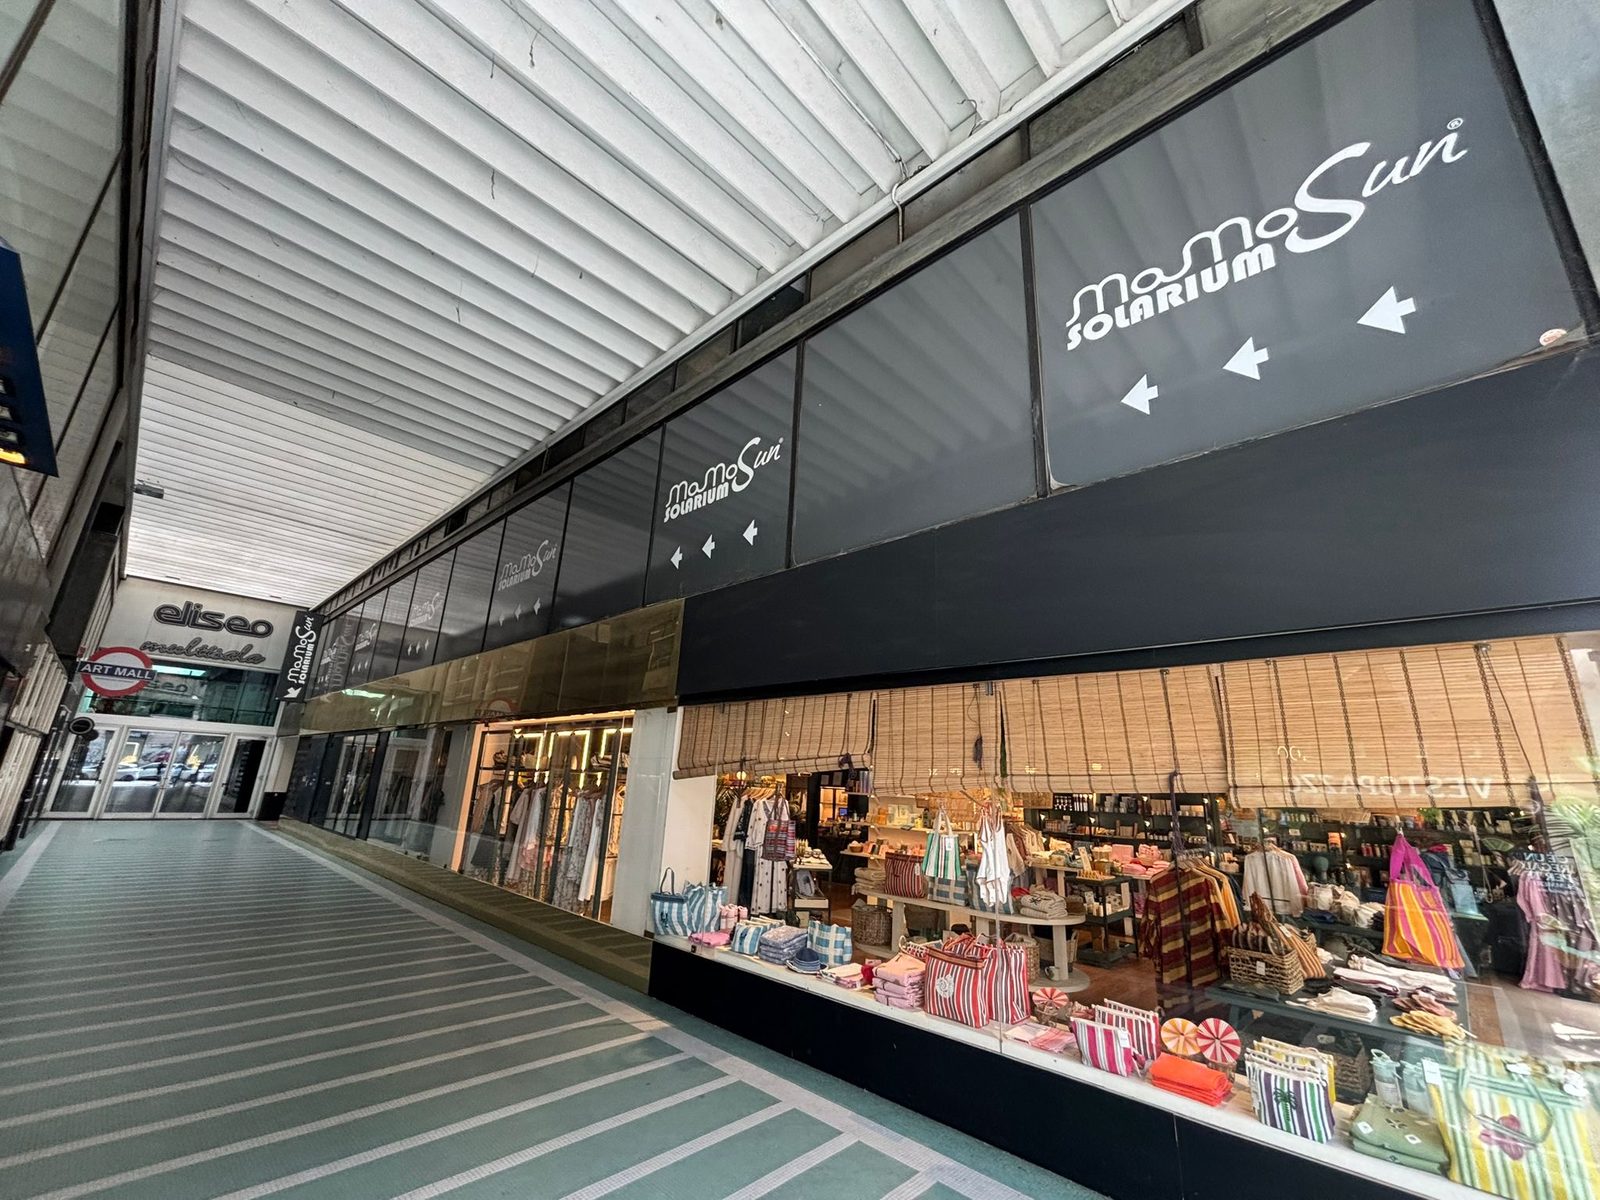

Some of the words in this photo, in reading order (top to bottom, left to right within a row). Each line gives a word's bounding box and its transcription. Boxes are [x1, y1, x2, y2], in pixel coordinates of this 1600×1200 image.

[1067, 243, 1277, 350] SOLARIUM
[664, 482, 729, 523] SOLARIUM
[153, 600, 273, 638] eliseo
[140, 637, 266, 664] multisala
[298, 643, 315, 684] SOLARIUM
[80, 663, 112, 676] ART
[114, 667, 153, 681] MALL
